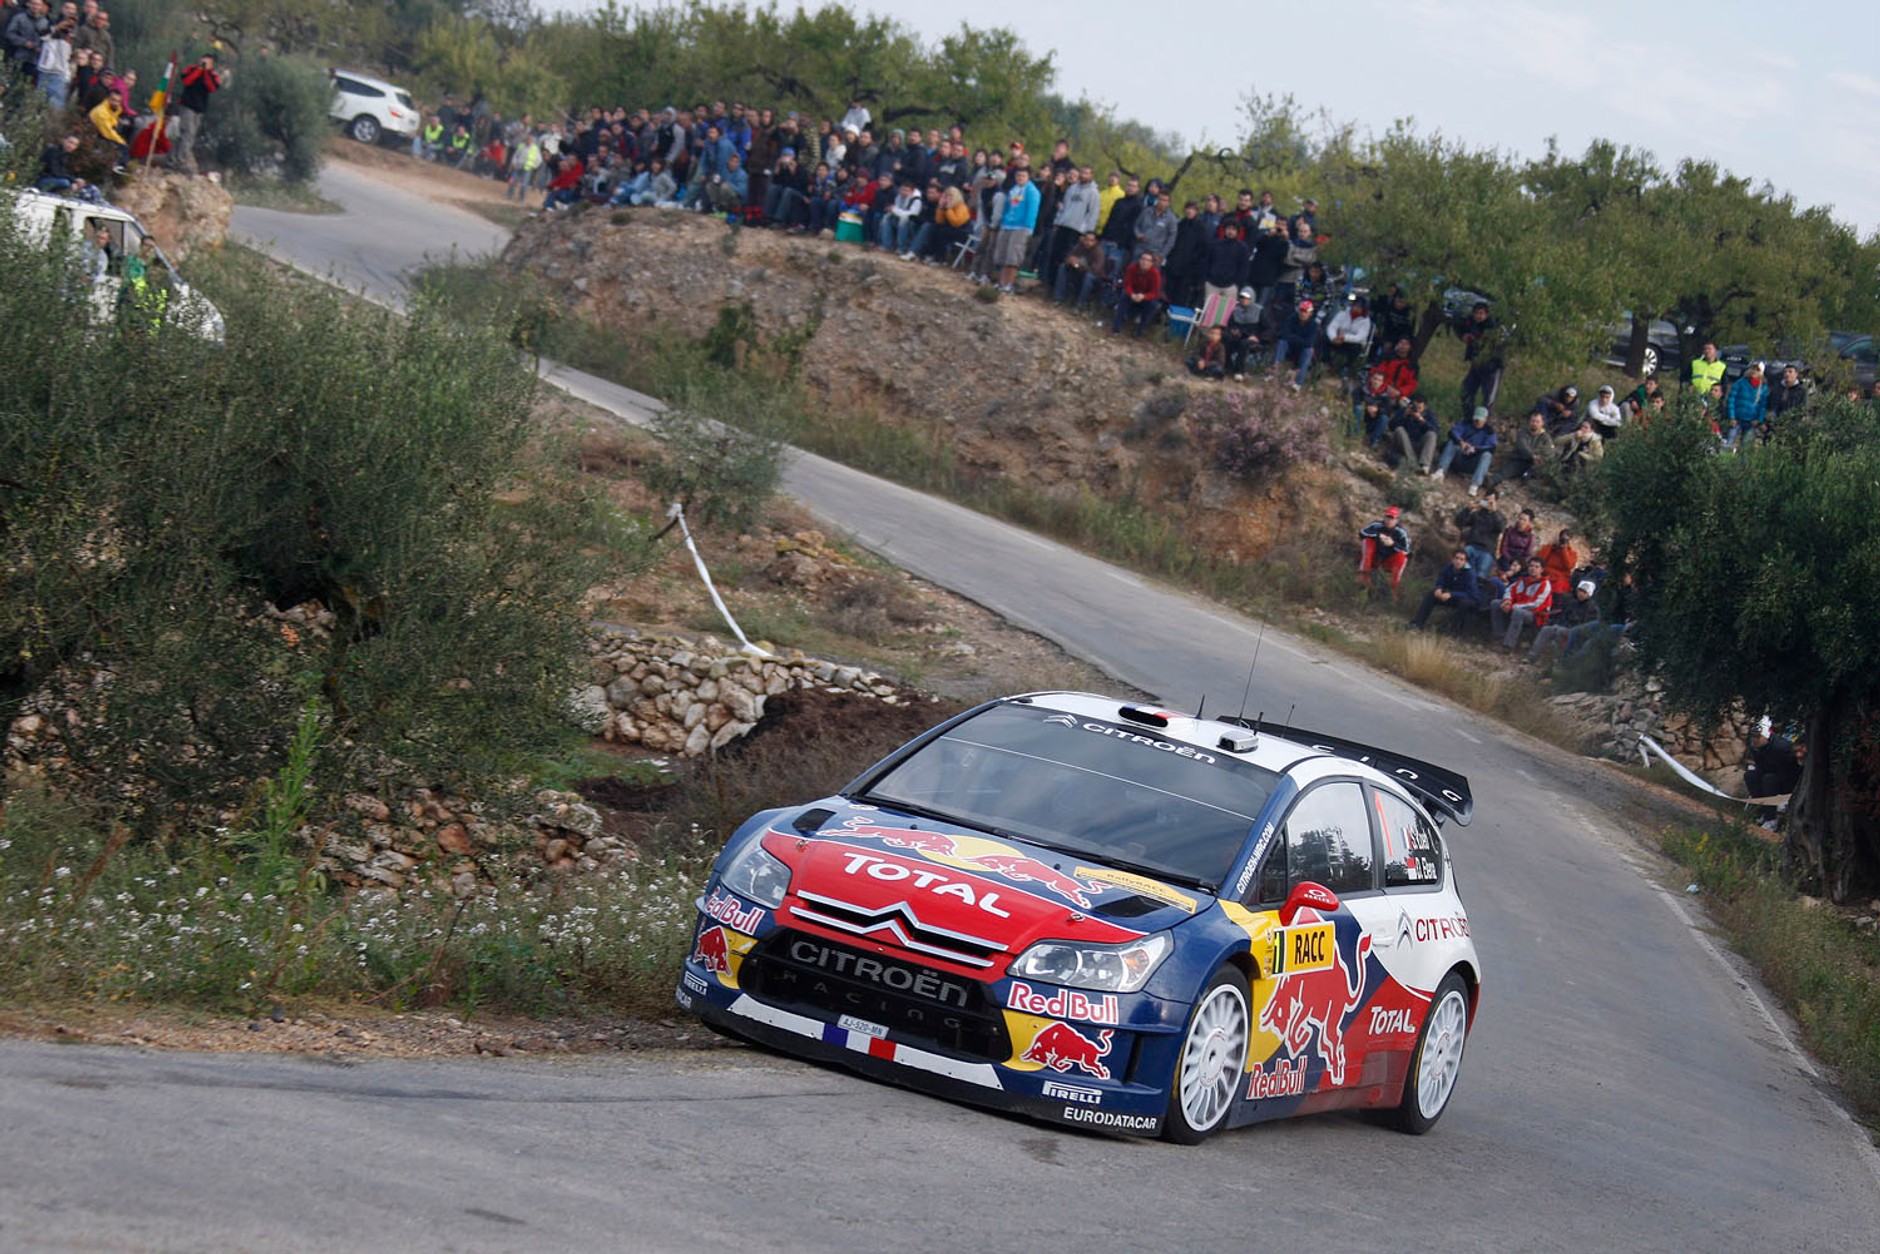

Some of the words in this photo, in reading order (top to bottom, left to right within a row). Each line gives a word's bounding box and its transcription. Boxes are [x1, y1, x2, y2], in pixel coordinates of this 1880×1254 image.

[844, 852, 1012, 918] TOTAL
[720, 898, 766, 935] Bull
[1416, 911, 1470, 942] CITROË
[1294, 930, 1325, 965] RACC
[1368, 1005, 1416, 1035] TOTAL
[1042, 1080, 1103, 1104] PIRELLI
[1063, 1106, 1158, 1130] EURODATACAR
